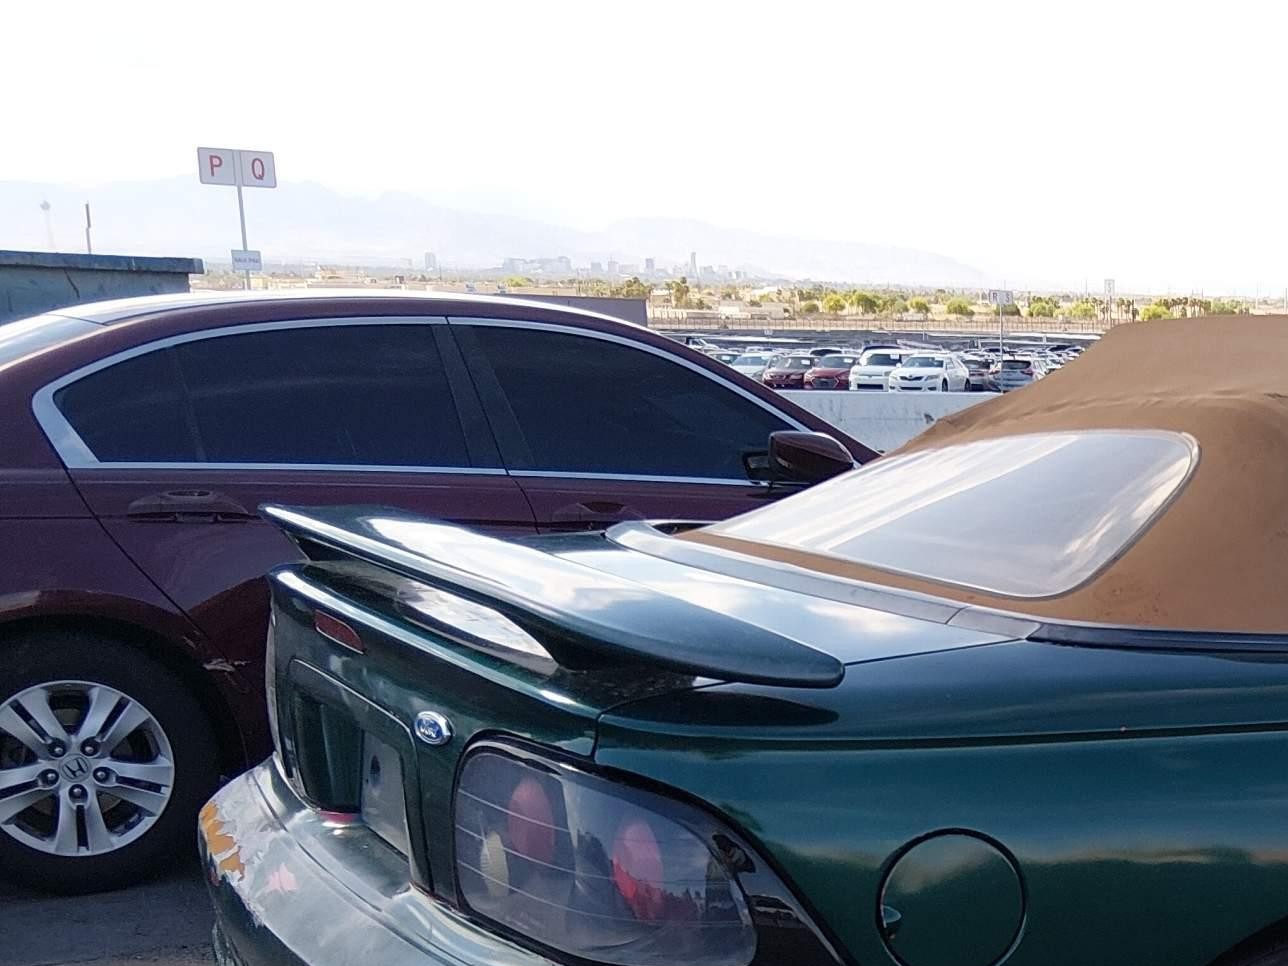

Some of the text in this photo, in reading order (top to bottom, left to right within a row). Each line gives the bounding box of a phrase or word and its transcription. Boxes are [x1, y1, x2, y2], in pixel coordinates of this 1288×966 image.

[208, 154, 223, 177] P
[251, 157, 265, 180] Q
[992, 292, 998, 301] R
